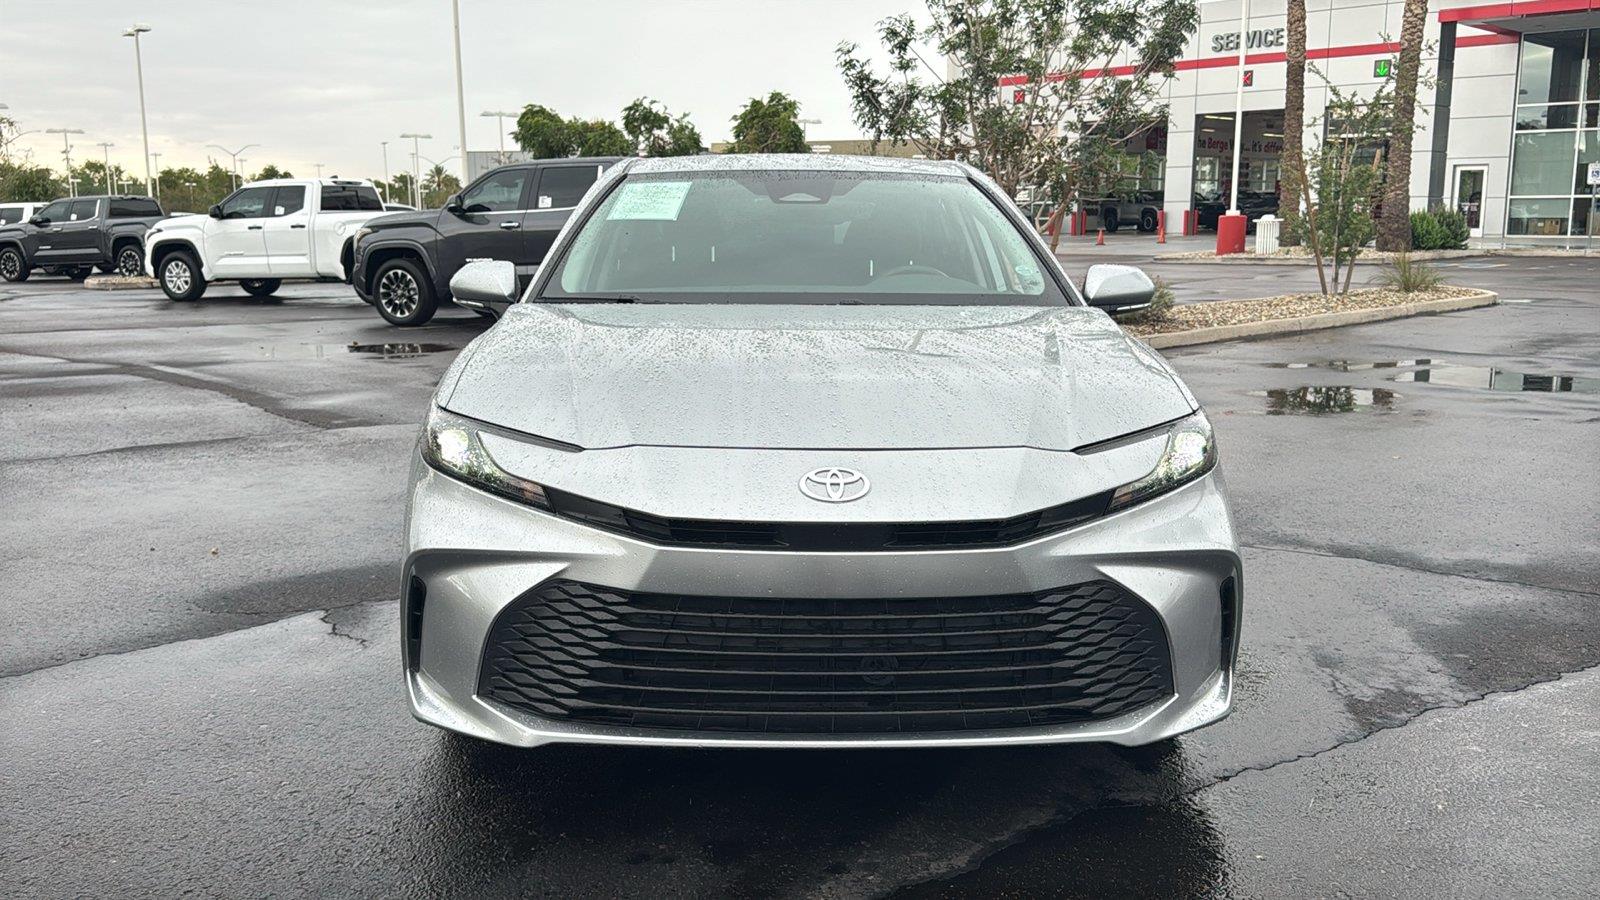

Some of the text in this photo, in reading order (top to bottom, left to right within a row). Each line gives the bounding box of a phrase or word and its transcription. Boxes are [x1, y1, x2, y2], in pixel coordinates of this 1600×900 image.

[1211, 28, 1285, 52] SERVICE
[1197, 136, 1206, 149] he
[1207, 137, 1228, 153] Berge
[1251, 140, 1263, 152] it's
